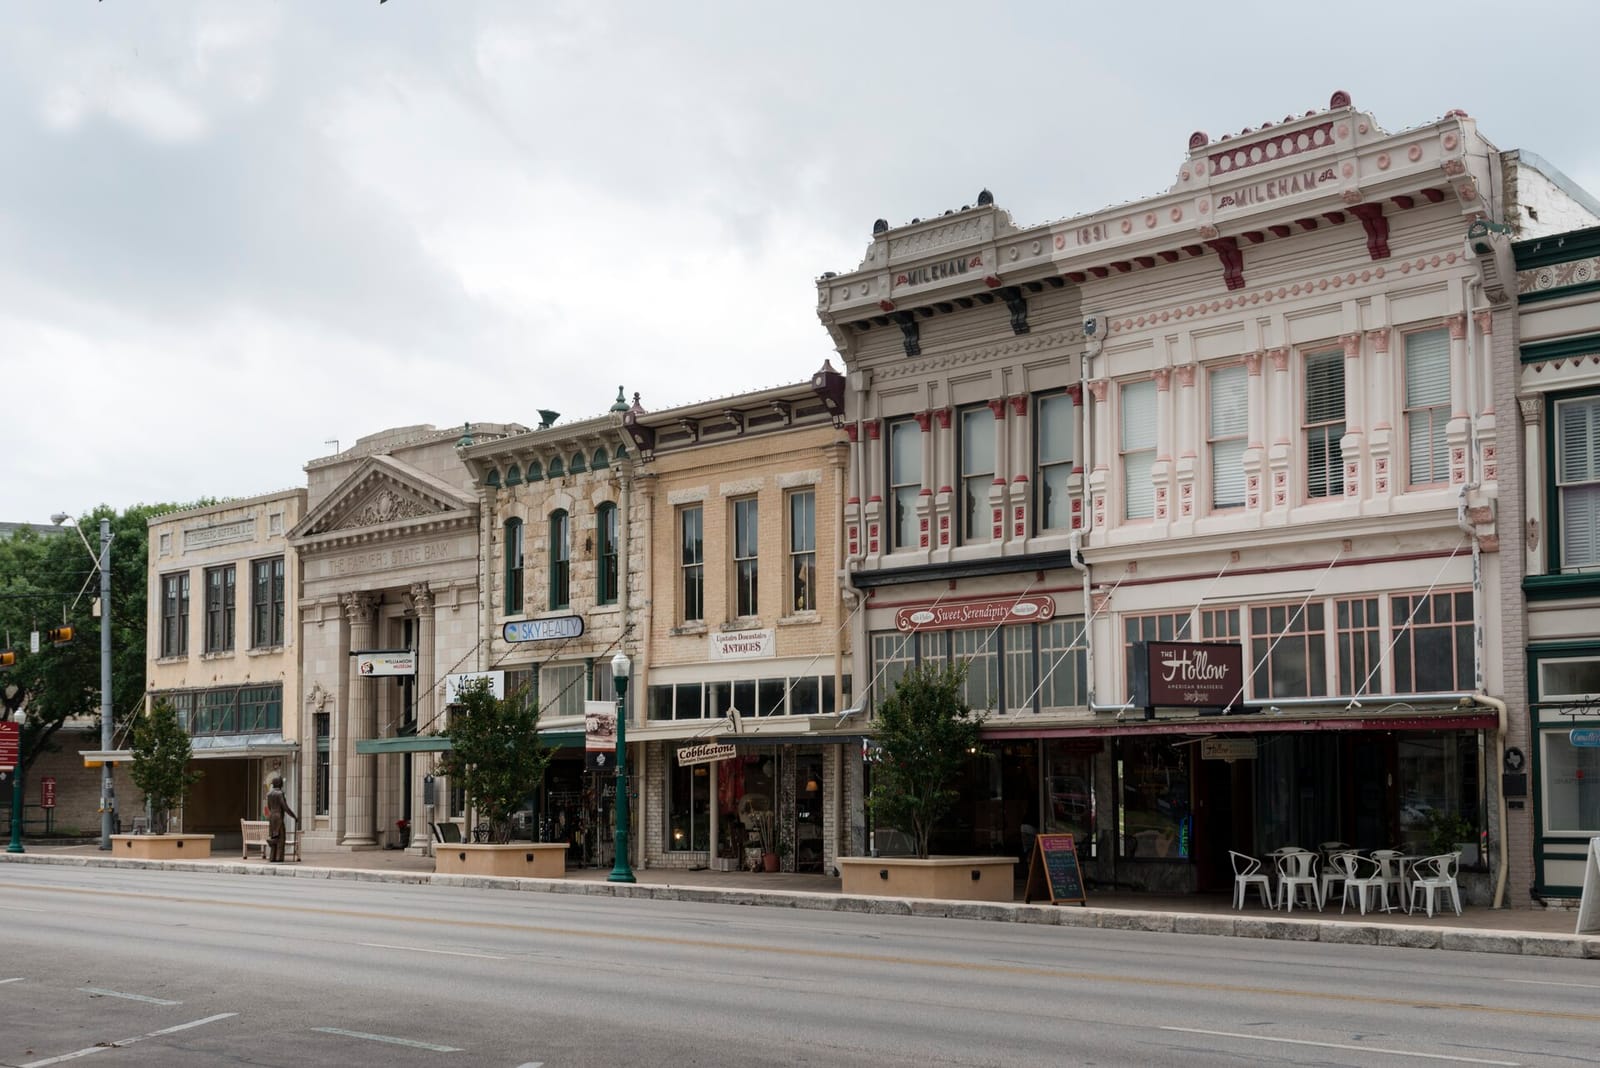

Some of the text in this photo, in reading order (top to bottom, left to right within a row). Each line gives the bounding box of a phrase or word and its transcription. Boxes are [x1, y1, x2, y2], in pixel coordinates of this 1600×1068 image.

[1235, 171, 1317, 208] MILEHAM
[908, 256, 969, 286] MILEHAM
[391, 547, 420, 565] STATE
[424, 543, 449, 560] BANK
[934, 607, 960, 624] Sweet
[961, 603, 1009, 622] Serendipity
[722, 641, 761, 654] ANTIQUES
[1162, 649, 1229, 682] Hollow
[679, 744, 734, 760] Cobblestone
